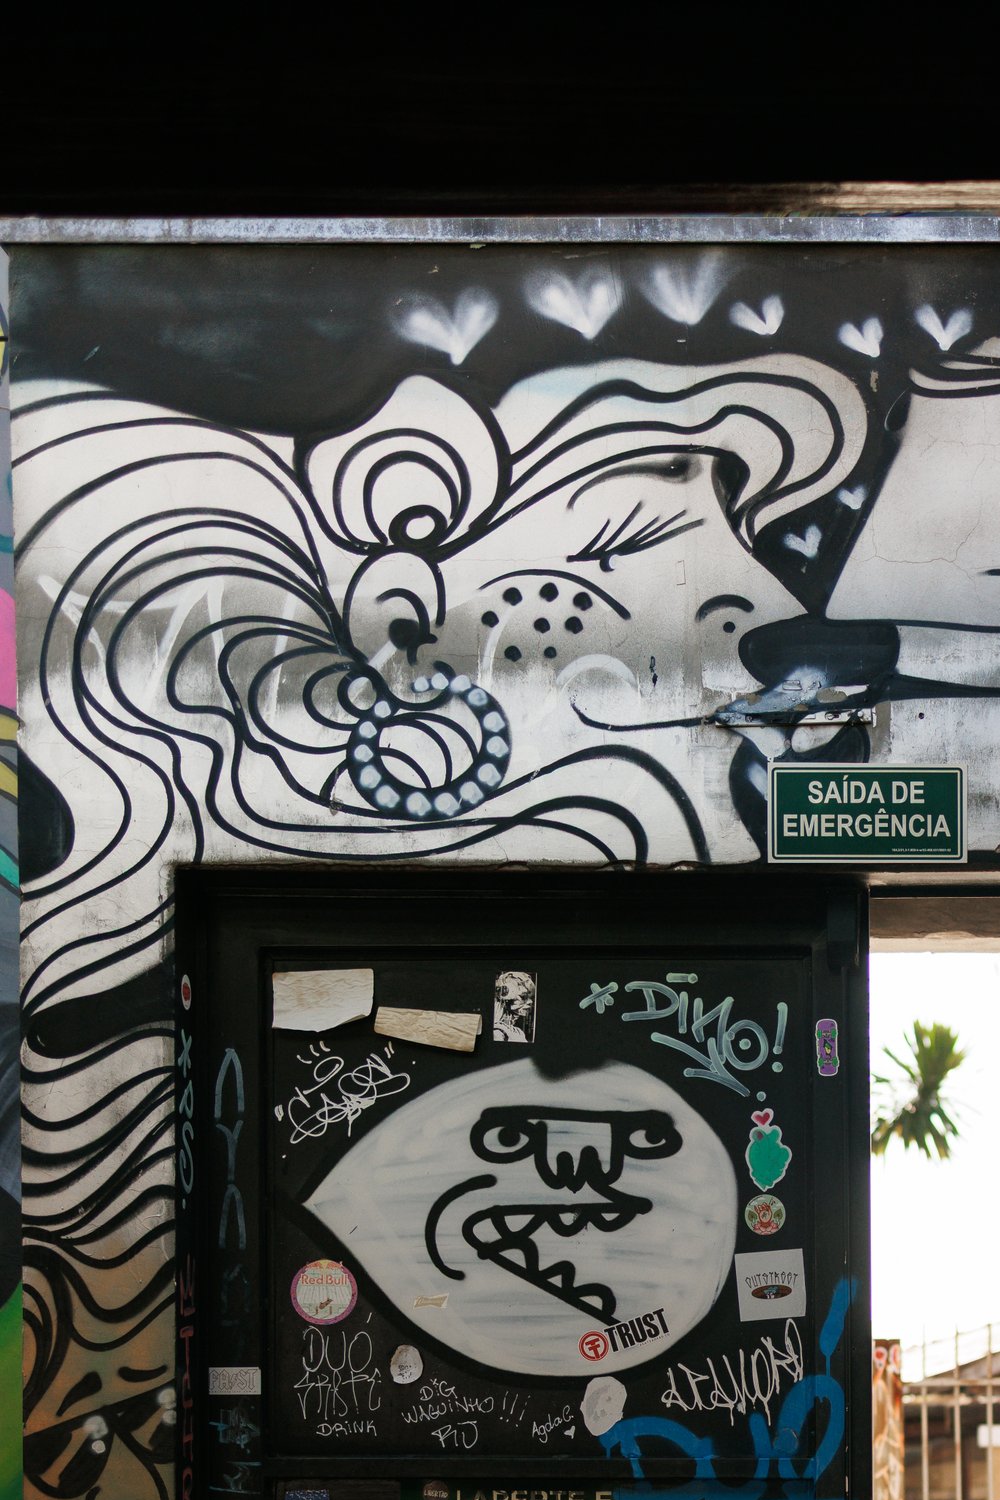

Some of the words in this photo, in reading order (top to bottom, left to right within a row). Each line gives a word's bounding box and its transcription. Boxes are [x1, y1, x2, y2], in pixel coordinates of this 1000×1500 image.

[807, 774, 885, 804] SAÍDA
[891, 780, 925, 804] DE
[783, 808, 951, 837] EMERGÊNCIA
[301, 1274, 324, 1285] Red
[326, 1274, 348, 1285] Bull
[604, 1308, 669, 1352] TRUST
